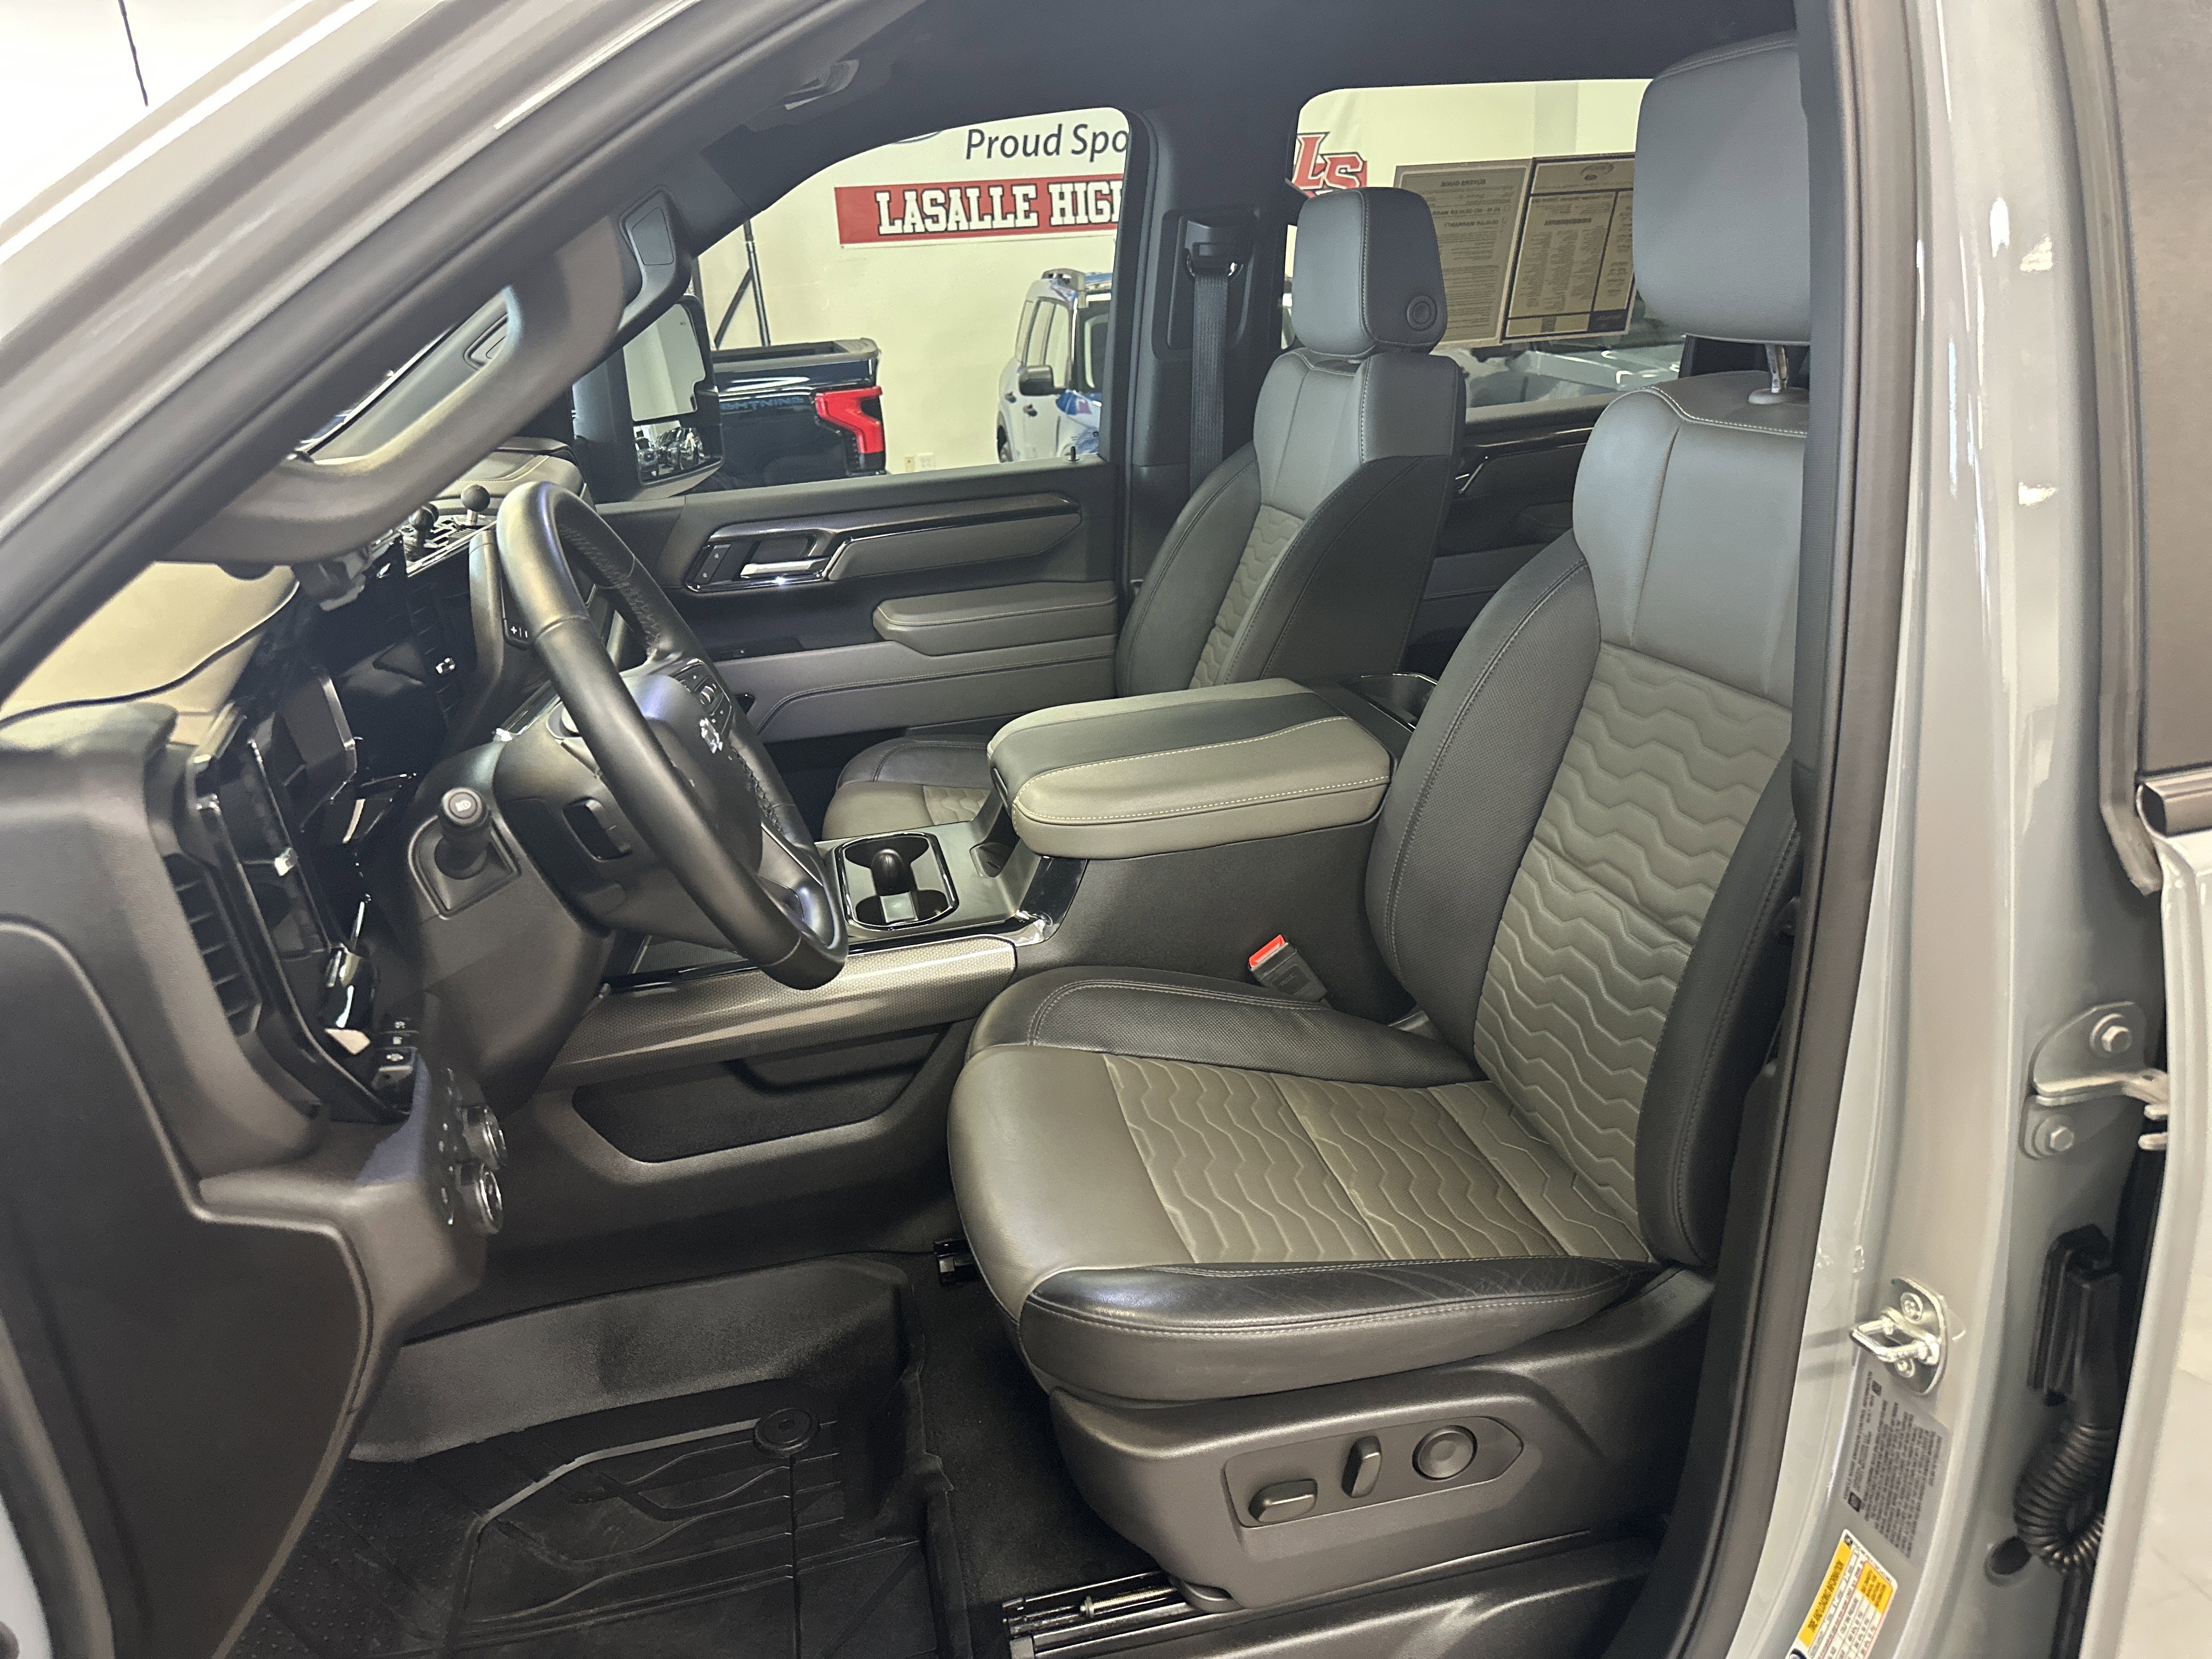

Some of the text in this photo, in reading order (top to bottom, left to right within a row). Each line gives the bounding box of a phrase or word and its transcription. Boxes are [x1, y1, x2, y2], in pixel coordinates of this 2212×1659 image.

[966, 123, 1129, 162] Proud Spo
[875, 184, 1039, 235] LASALLE
